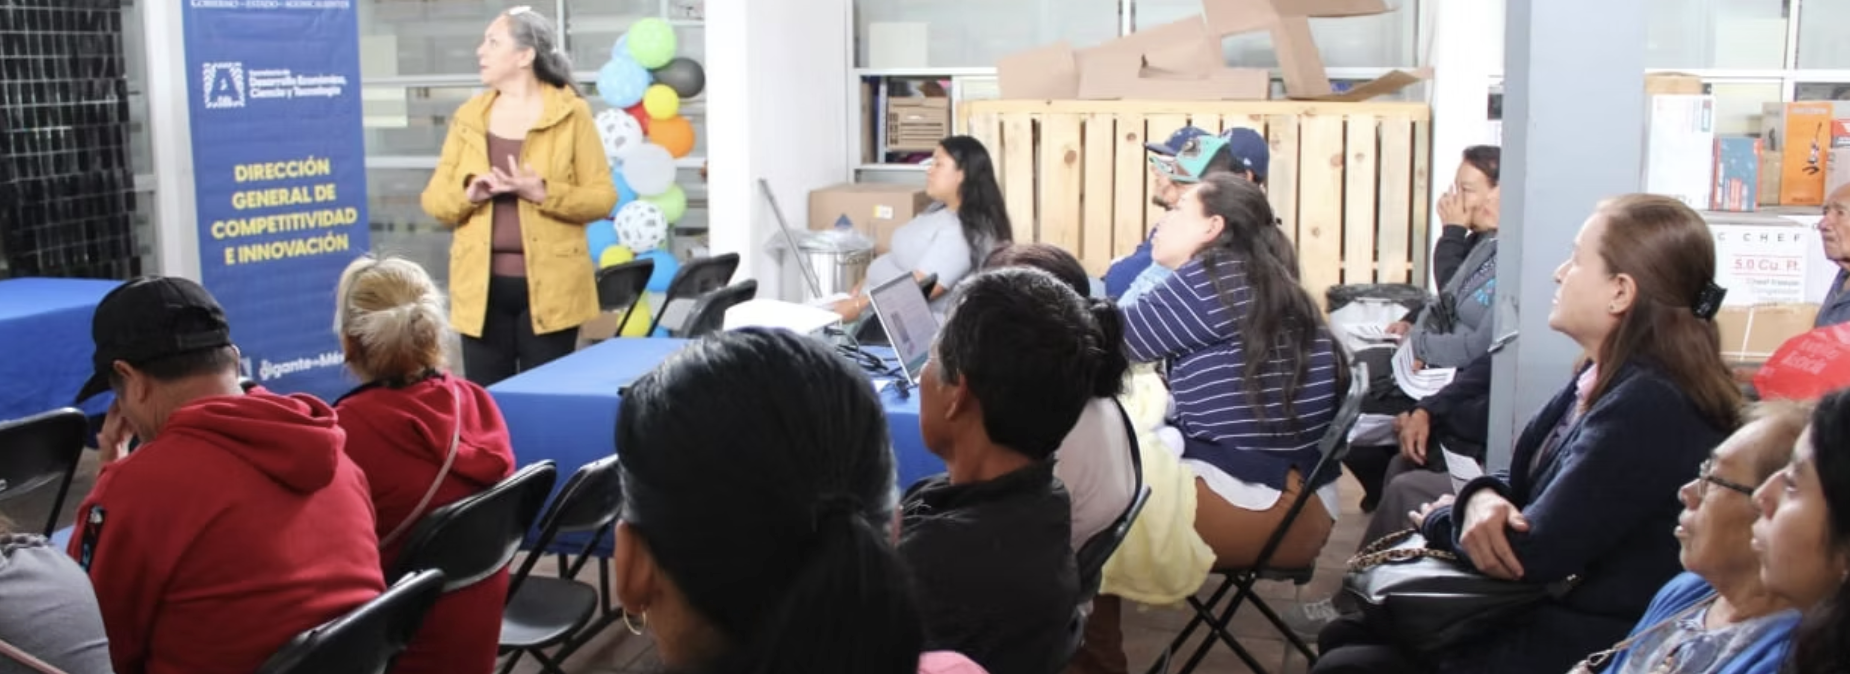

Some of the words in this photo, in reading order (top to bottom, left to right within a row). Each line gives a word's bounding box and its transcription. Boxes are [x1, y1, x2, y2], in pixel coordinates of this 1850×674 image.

[234, 155, 331, 183] DIRECCIÓN
[231, 186, 312, 210] GENERAL
[314, 183, 336, 203] DE
[211, 207, 358, 239] COMPETITIVIDAD
[225, 247, 236, 265] E
[238, 231, 349, 263] INNOVACIÓN
[1742, 233, 1801, 242] CHEF
